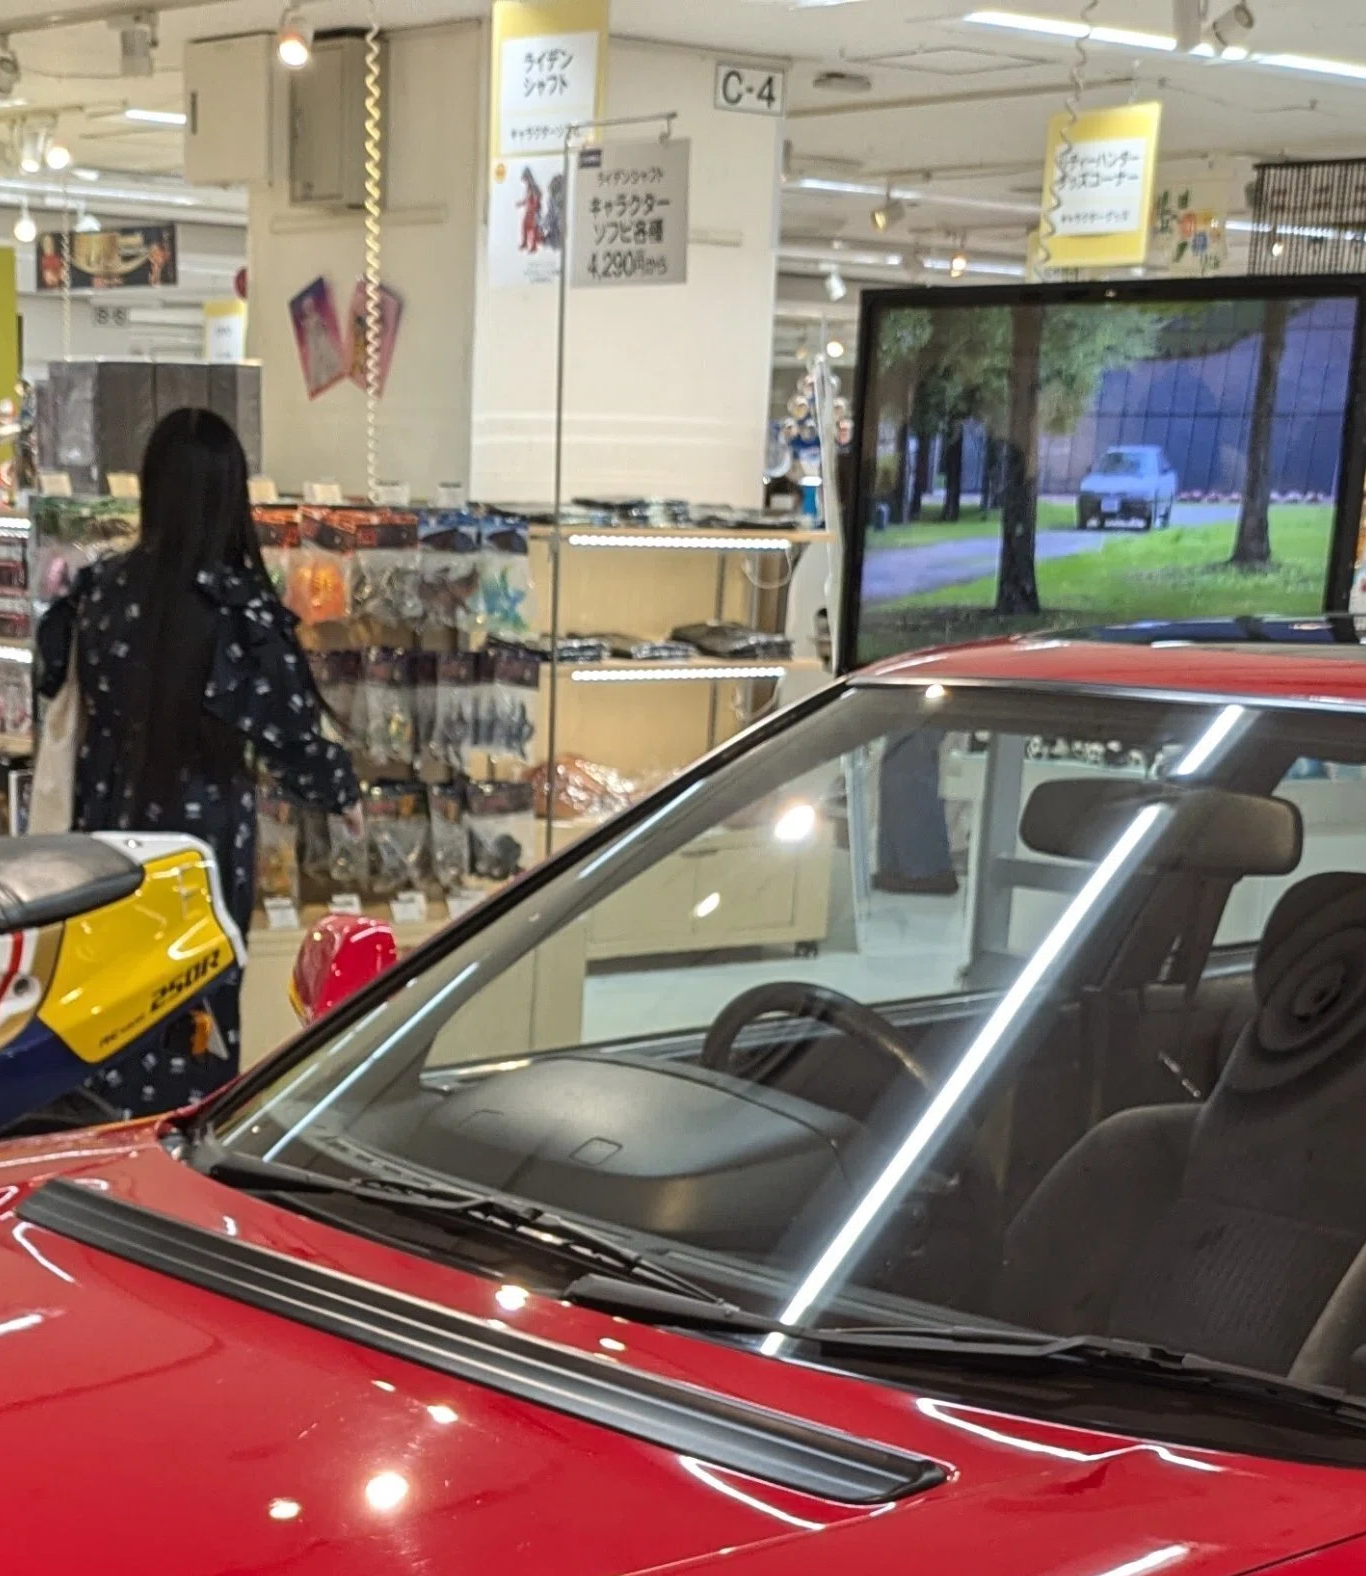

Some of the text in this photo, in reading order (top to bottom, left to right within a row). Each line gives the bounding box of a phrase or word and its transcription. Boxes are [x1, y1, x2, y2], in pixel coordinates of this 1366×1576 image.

[523, 48, 573, 73] ライデン
[523, 75, 569, 98] シャフト
[722, 69, 776, 109] C-4
[597, 167, 664, 186] ライデンシャフト
[589, 193, 670, 218] キャラクター
[592, 219, 663, 246] ソフビ各種
[588, 252, 668, 280] 4,290円から
